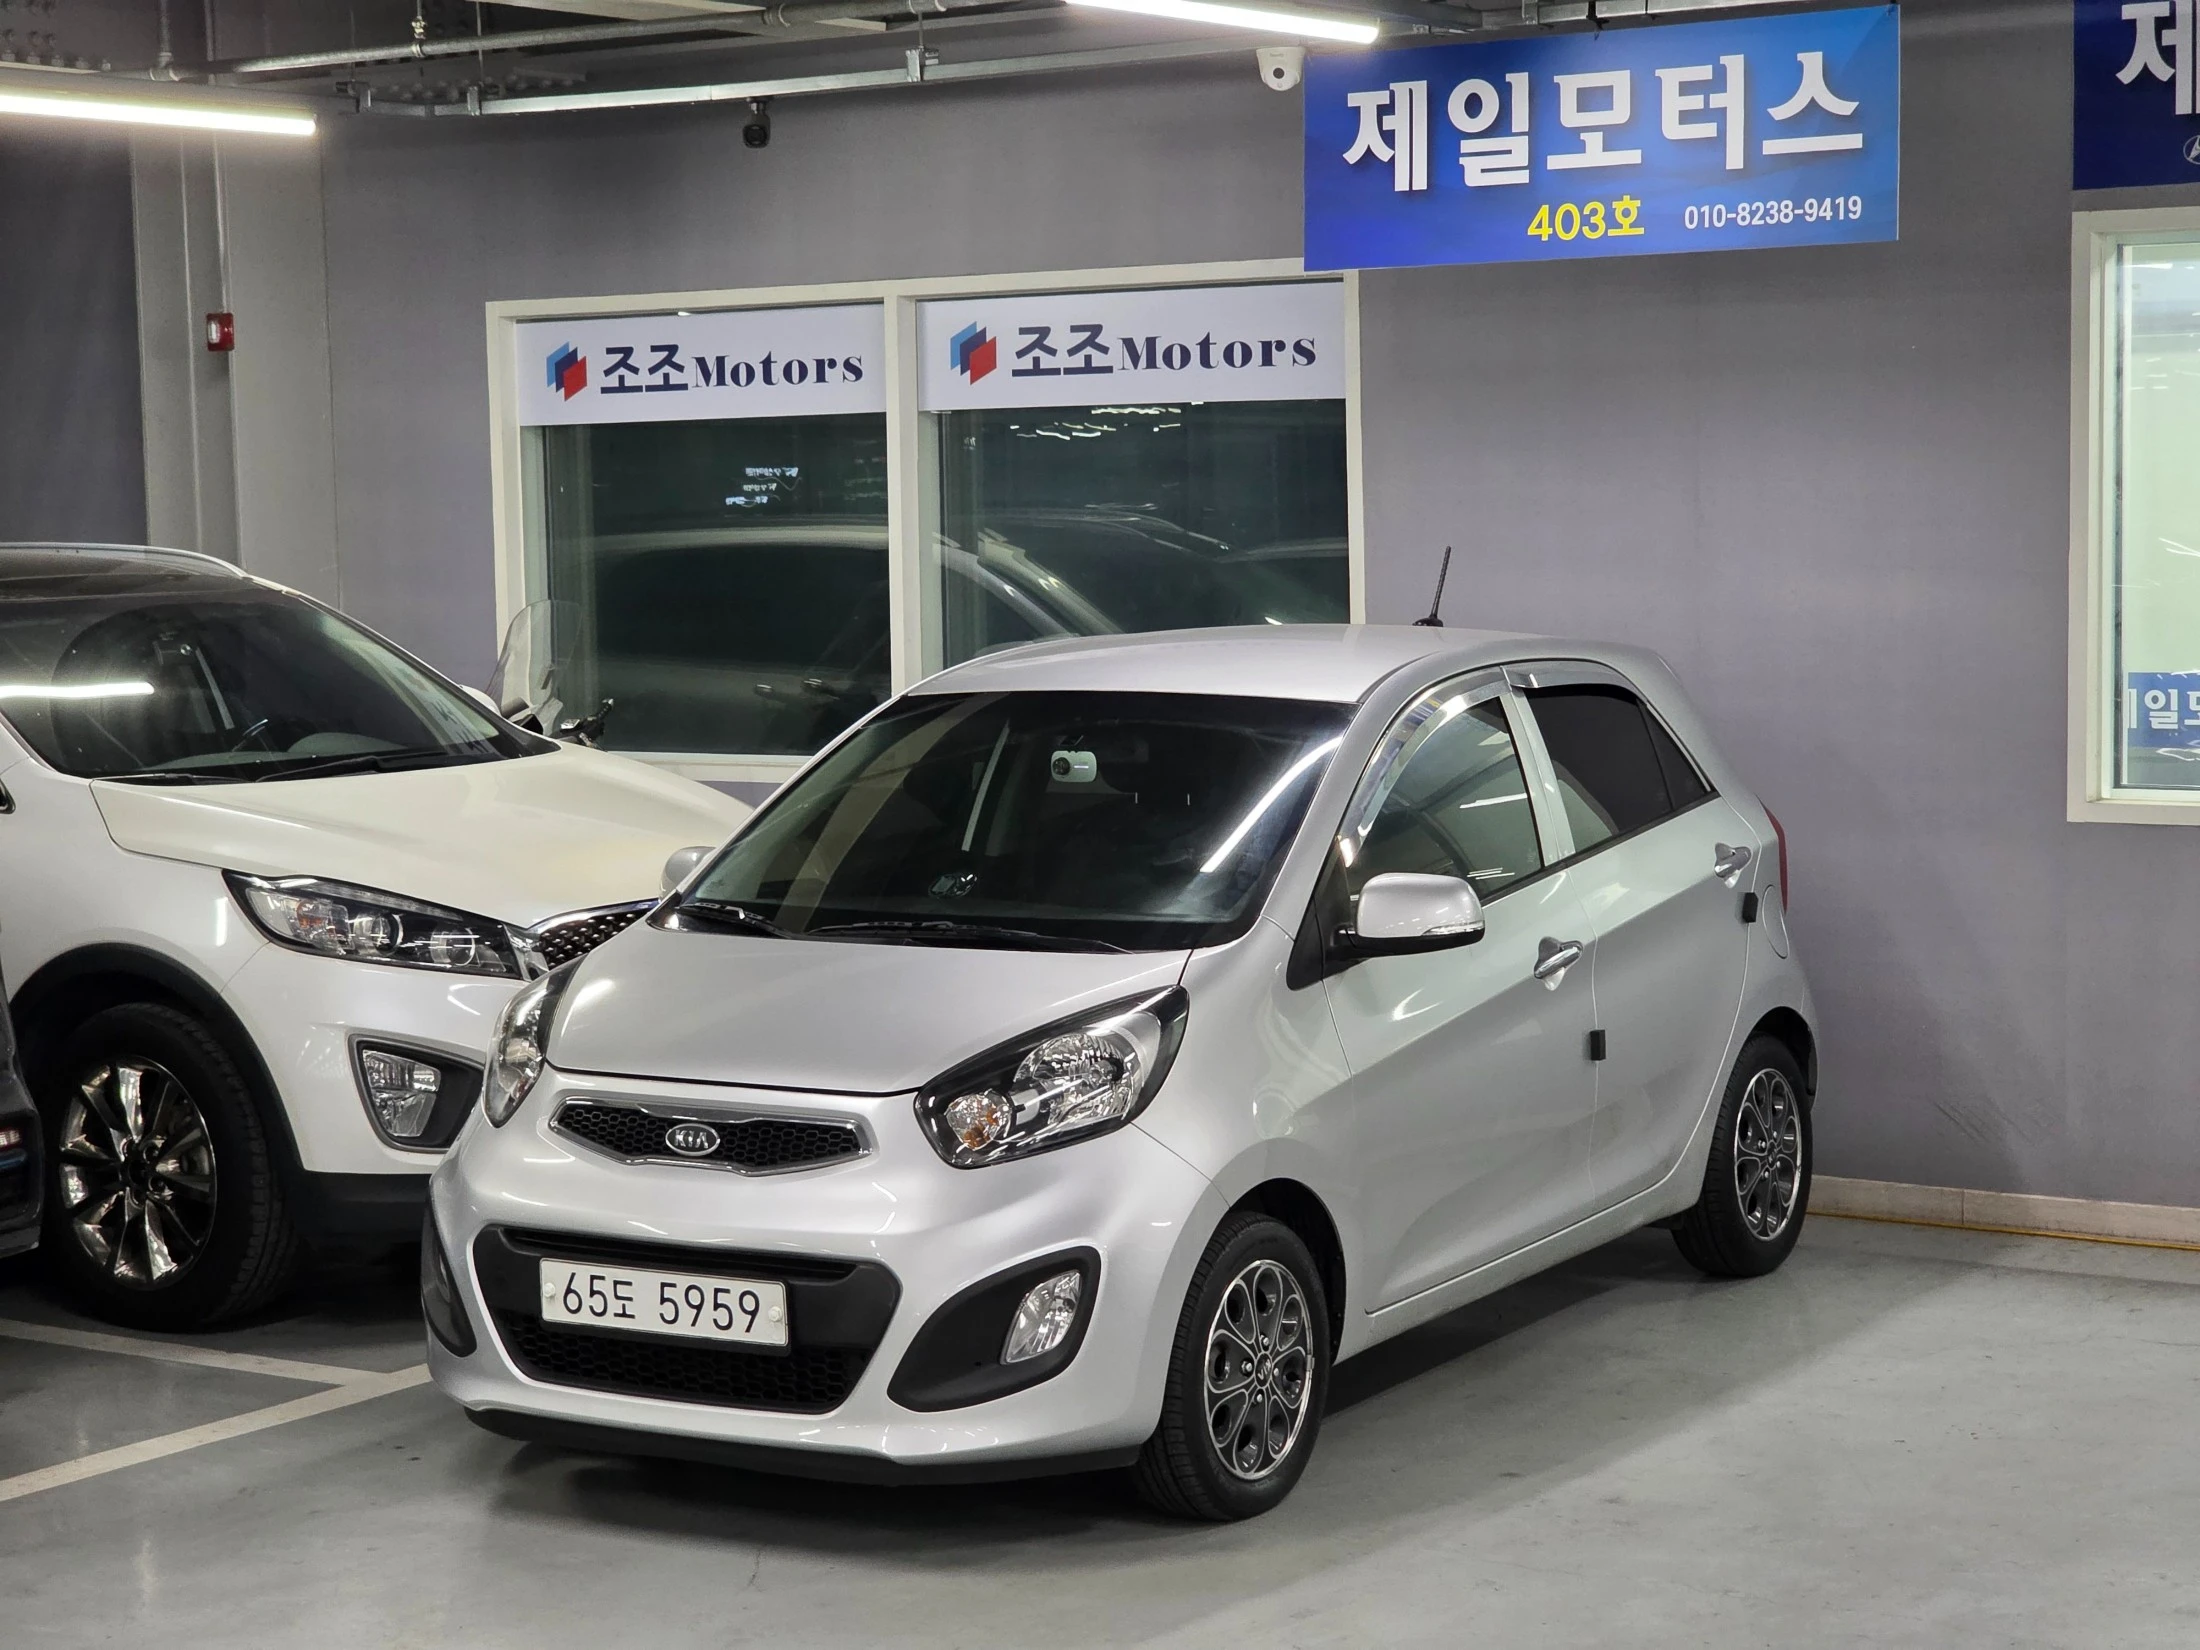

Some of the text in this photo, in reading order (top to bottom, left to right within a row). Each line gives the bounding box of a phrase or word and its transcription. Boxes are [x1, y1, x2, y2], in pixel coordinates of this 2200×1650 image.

[1342, 51, 1864, 192] 제일모터스
[1527, 195, 1863, 242] 403호 010-8238-9419
[674, 1129, 709, 1149] KIA
[562, 1272, 761, 1334] 65도 5959
